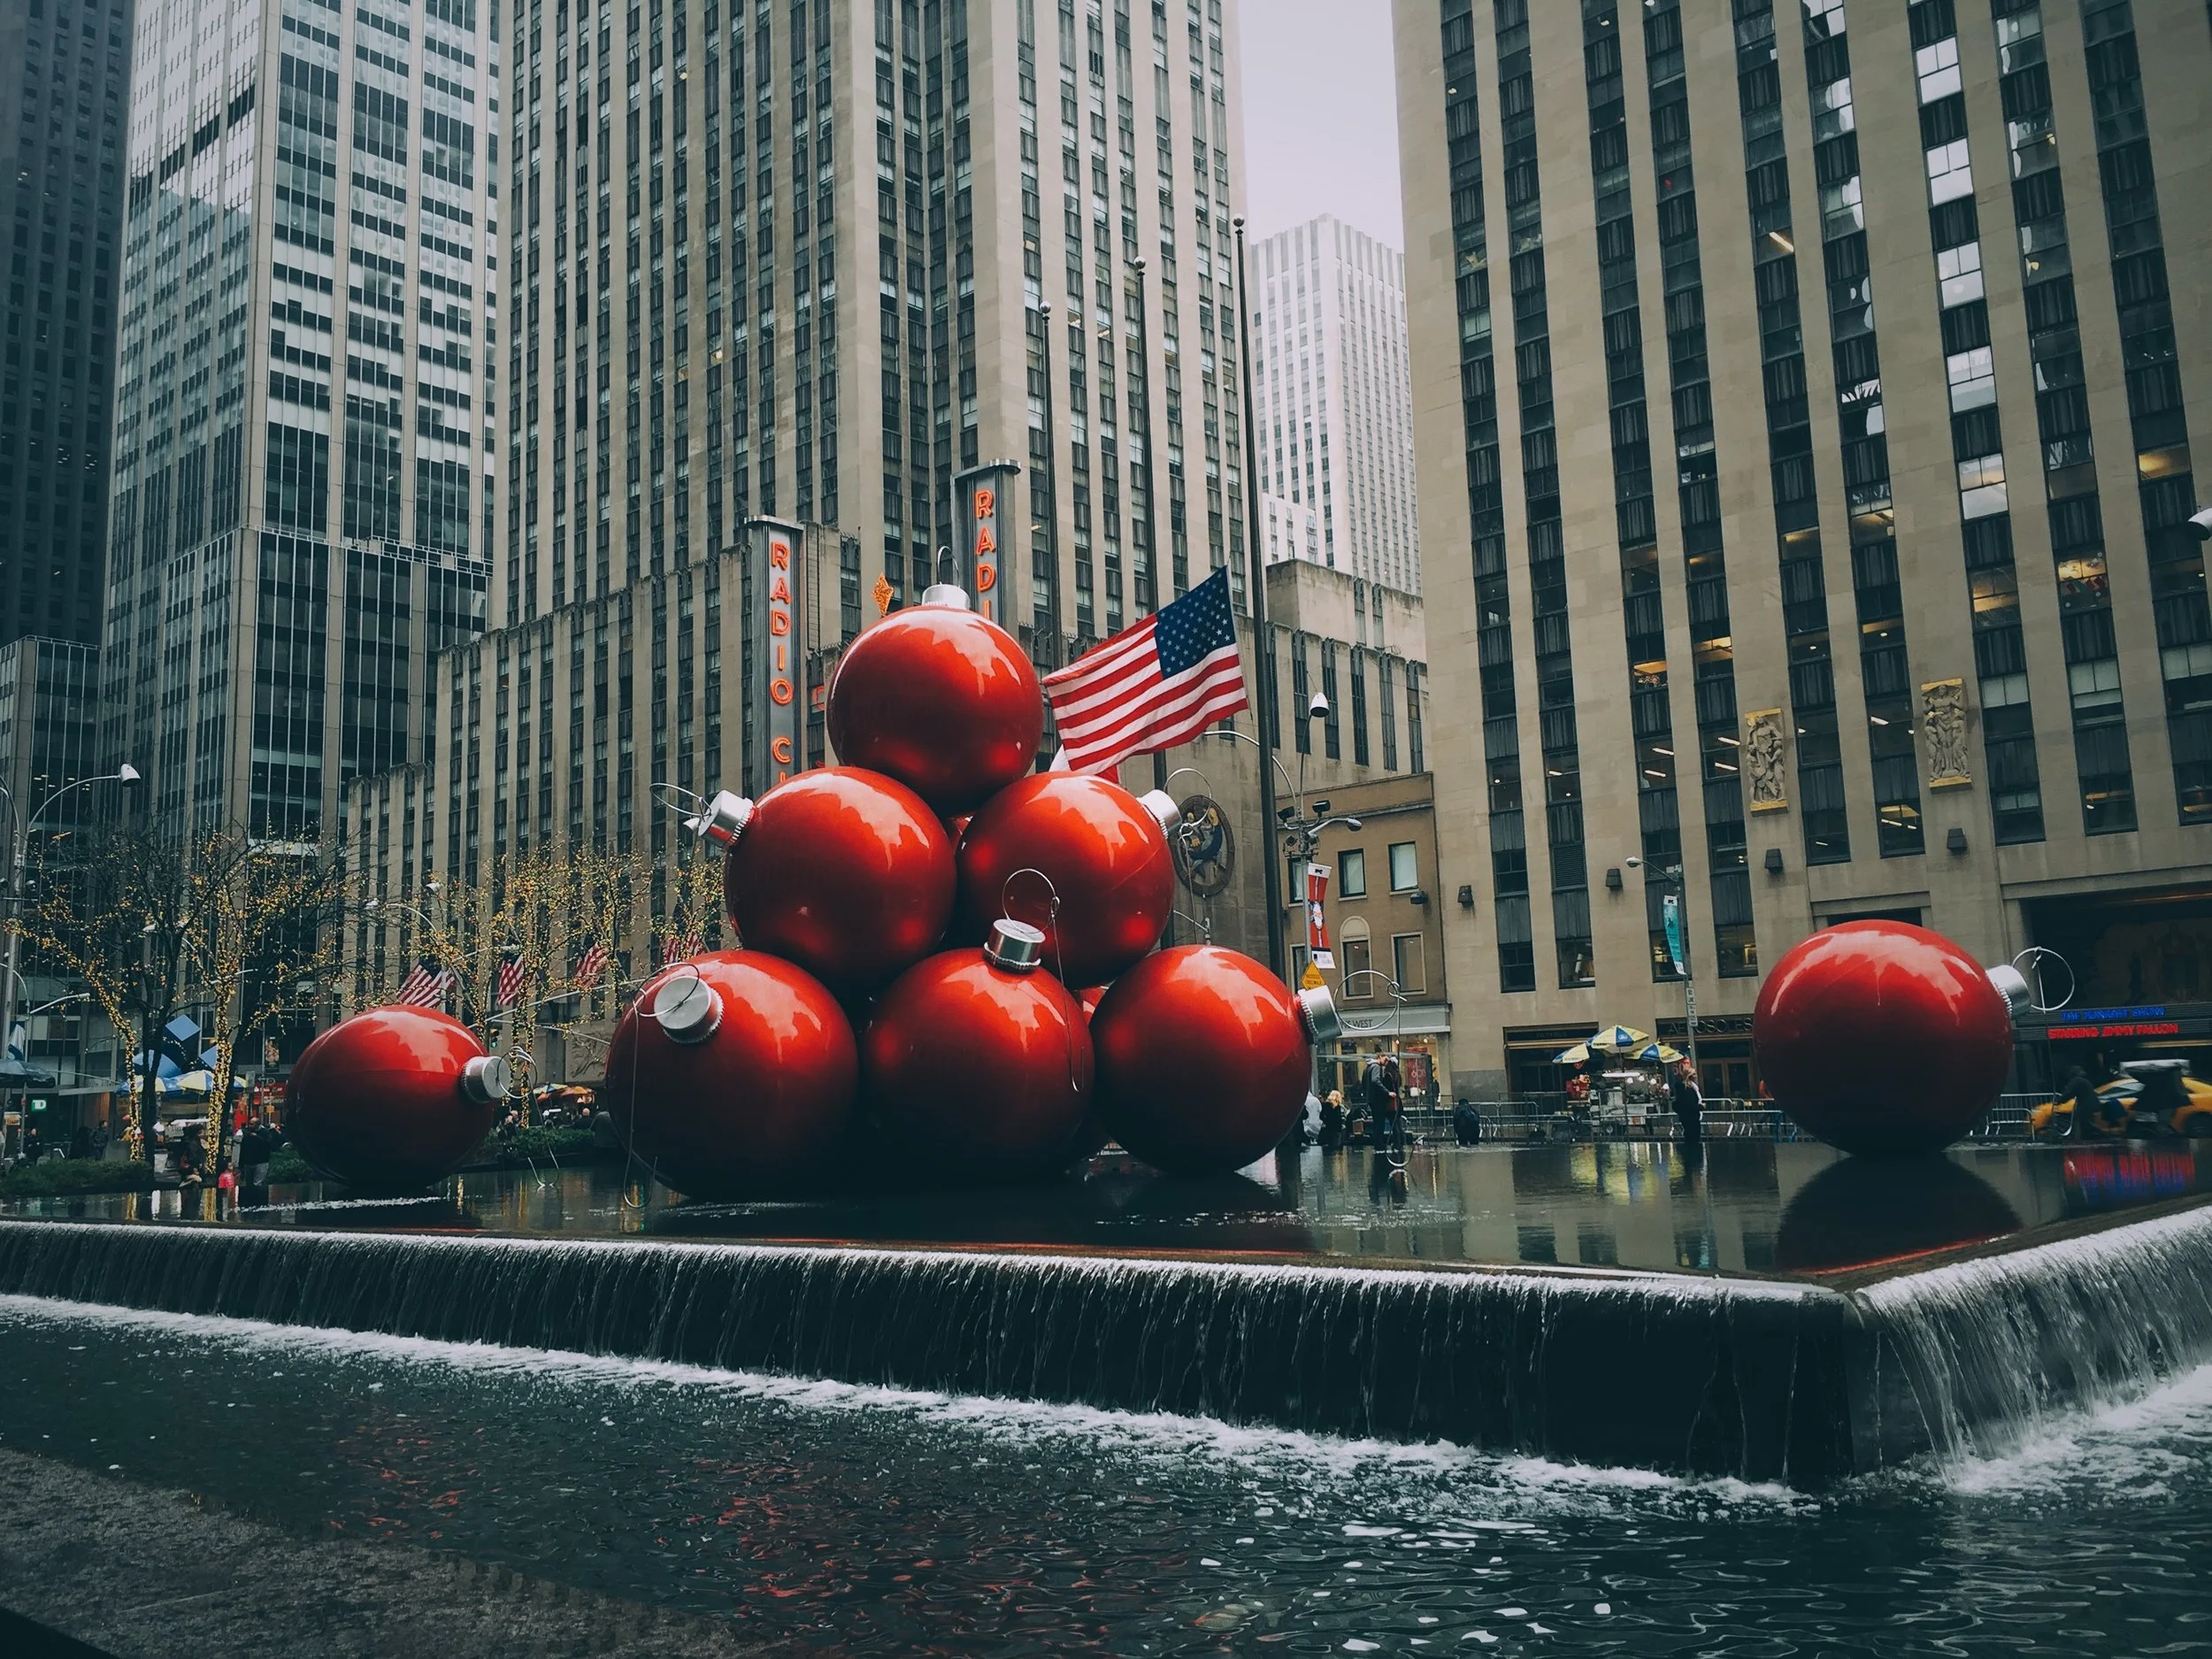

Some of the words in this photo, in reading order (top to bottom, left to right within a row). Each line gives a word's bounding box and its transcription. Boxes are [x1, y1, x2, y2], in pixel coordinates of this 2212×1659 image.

[975, 489, 996, 619] RADI
[770, 541, 794, 705] RADIO
[2132, 1006, 2166, 1017] SHOW
[1352, 1018, 1373, 1028] WEST
[2102, 1025, 2133, 1037] JIMMY
[34, 1099, 47, 1110] TD
